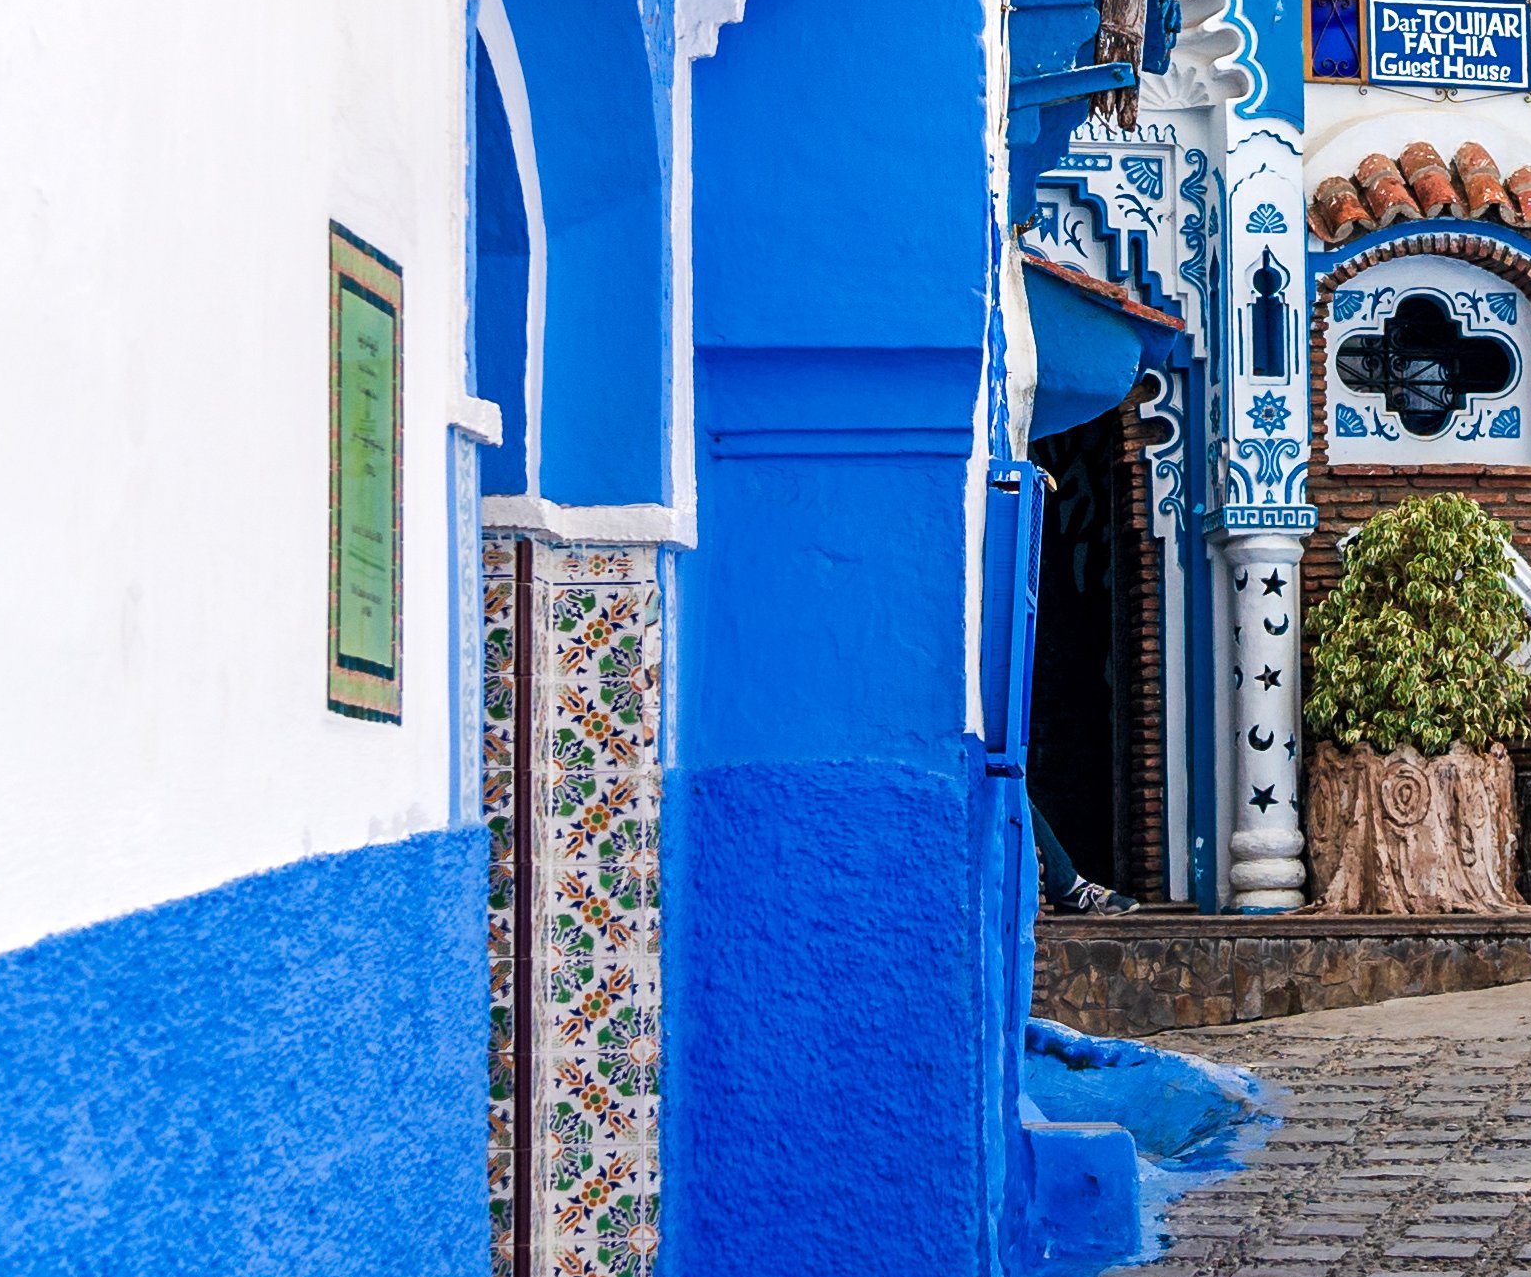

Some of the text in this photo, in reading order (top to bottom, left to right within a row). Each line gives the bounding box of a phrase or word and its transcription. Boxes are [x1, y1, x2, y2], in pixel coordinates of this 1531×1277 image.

[1382, 7, 1421, 32] Dar
[1402, 32, 1498, 58] FATHIA
[1379, 52, 1512, 82] Guest House
